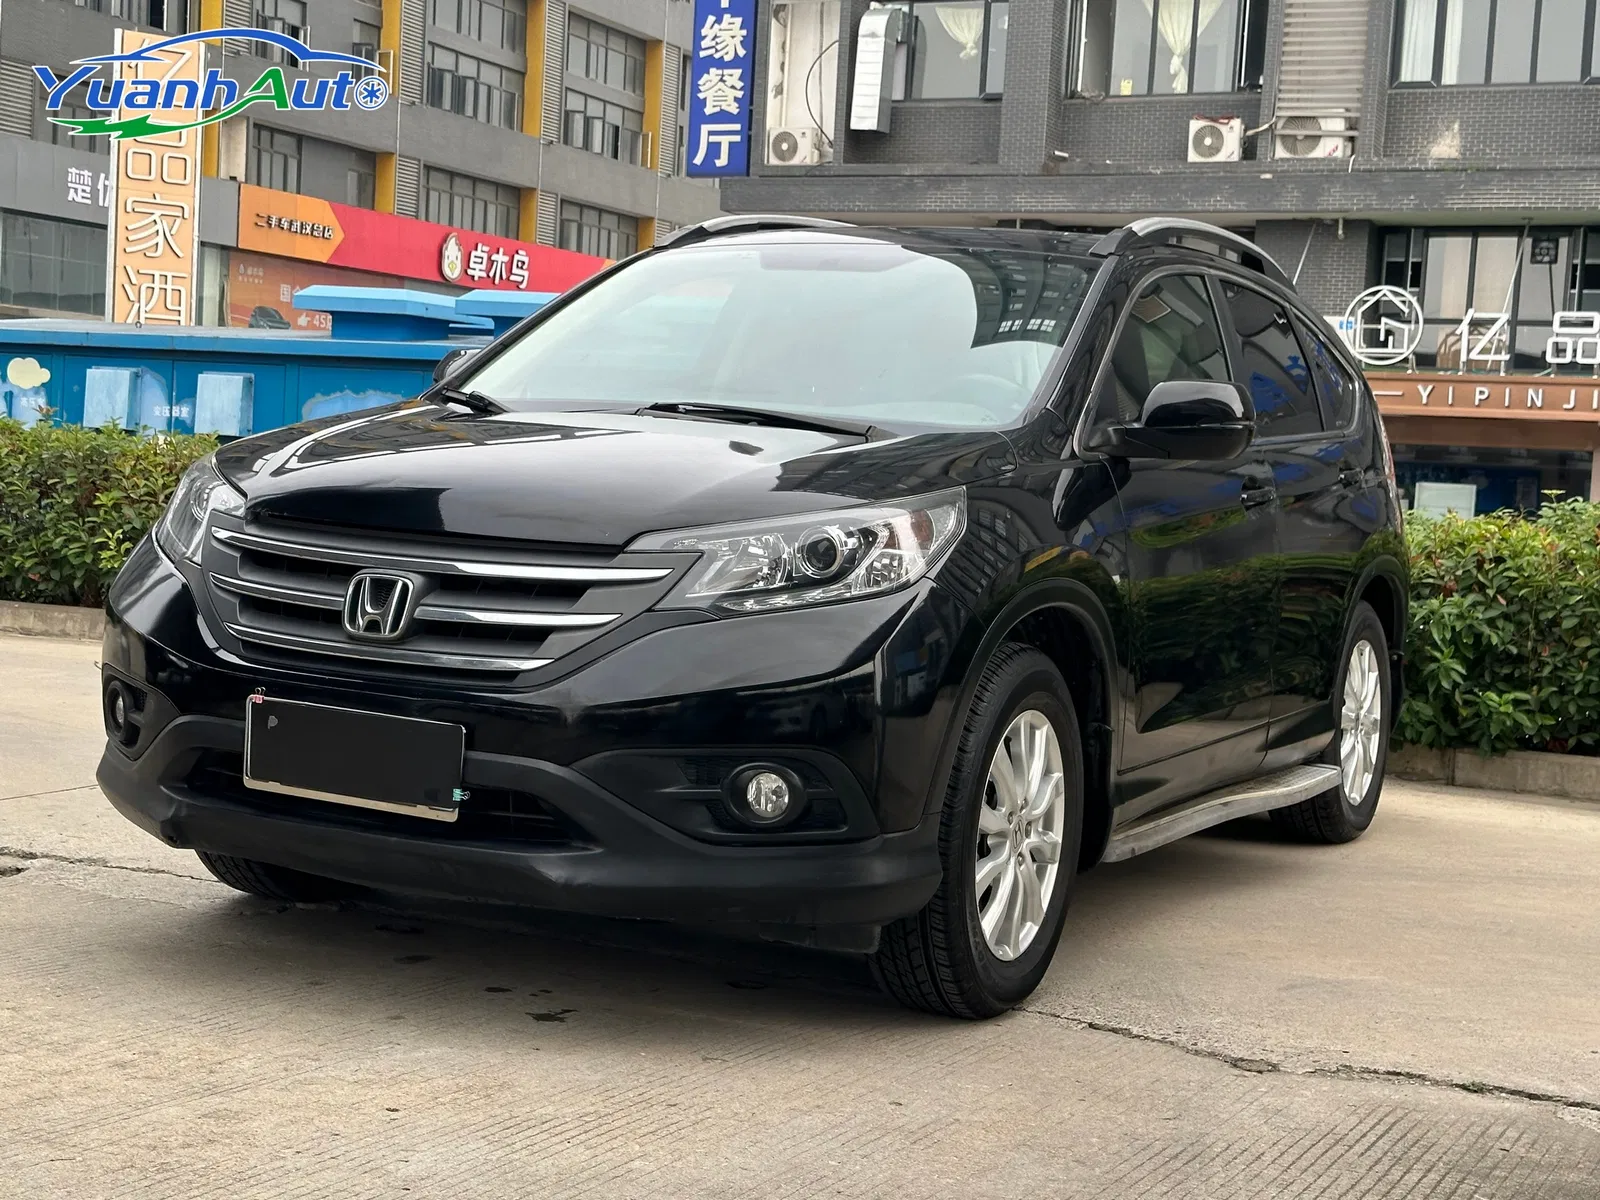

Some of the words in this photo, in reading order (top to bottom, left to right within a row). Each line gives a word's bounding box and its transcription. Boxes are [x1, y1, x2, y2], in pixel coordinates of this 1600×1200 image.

[693, 0, 747, 167] 缘餐厅
[254, 212, 334, 239] 二手车武汉总店
[467, 242, 530, 289] 卓木鸟
[280, 283, 301, 303] 国
[1455, 308, 1600, 364] 亿品
